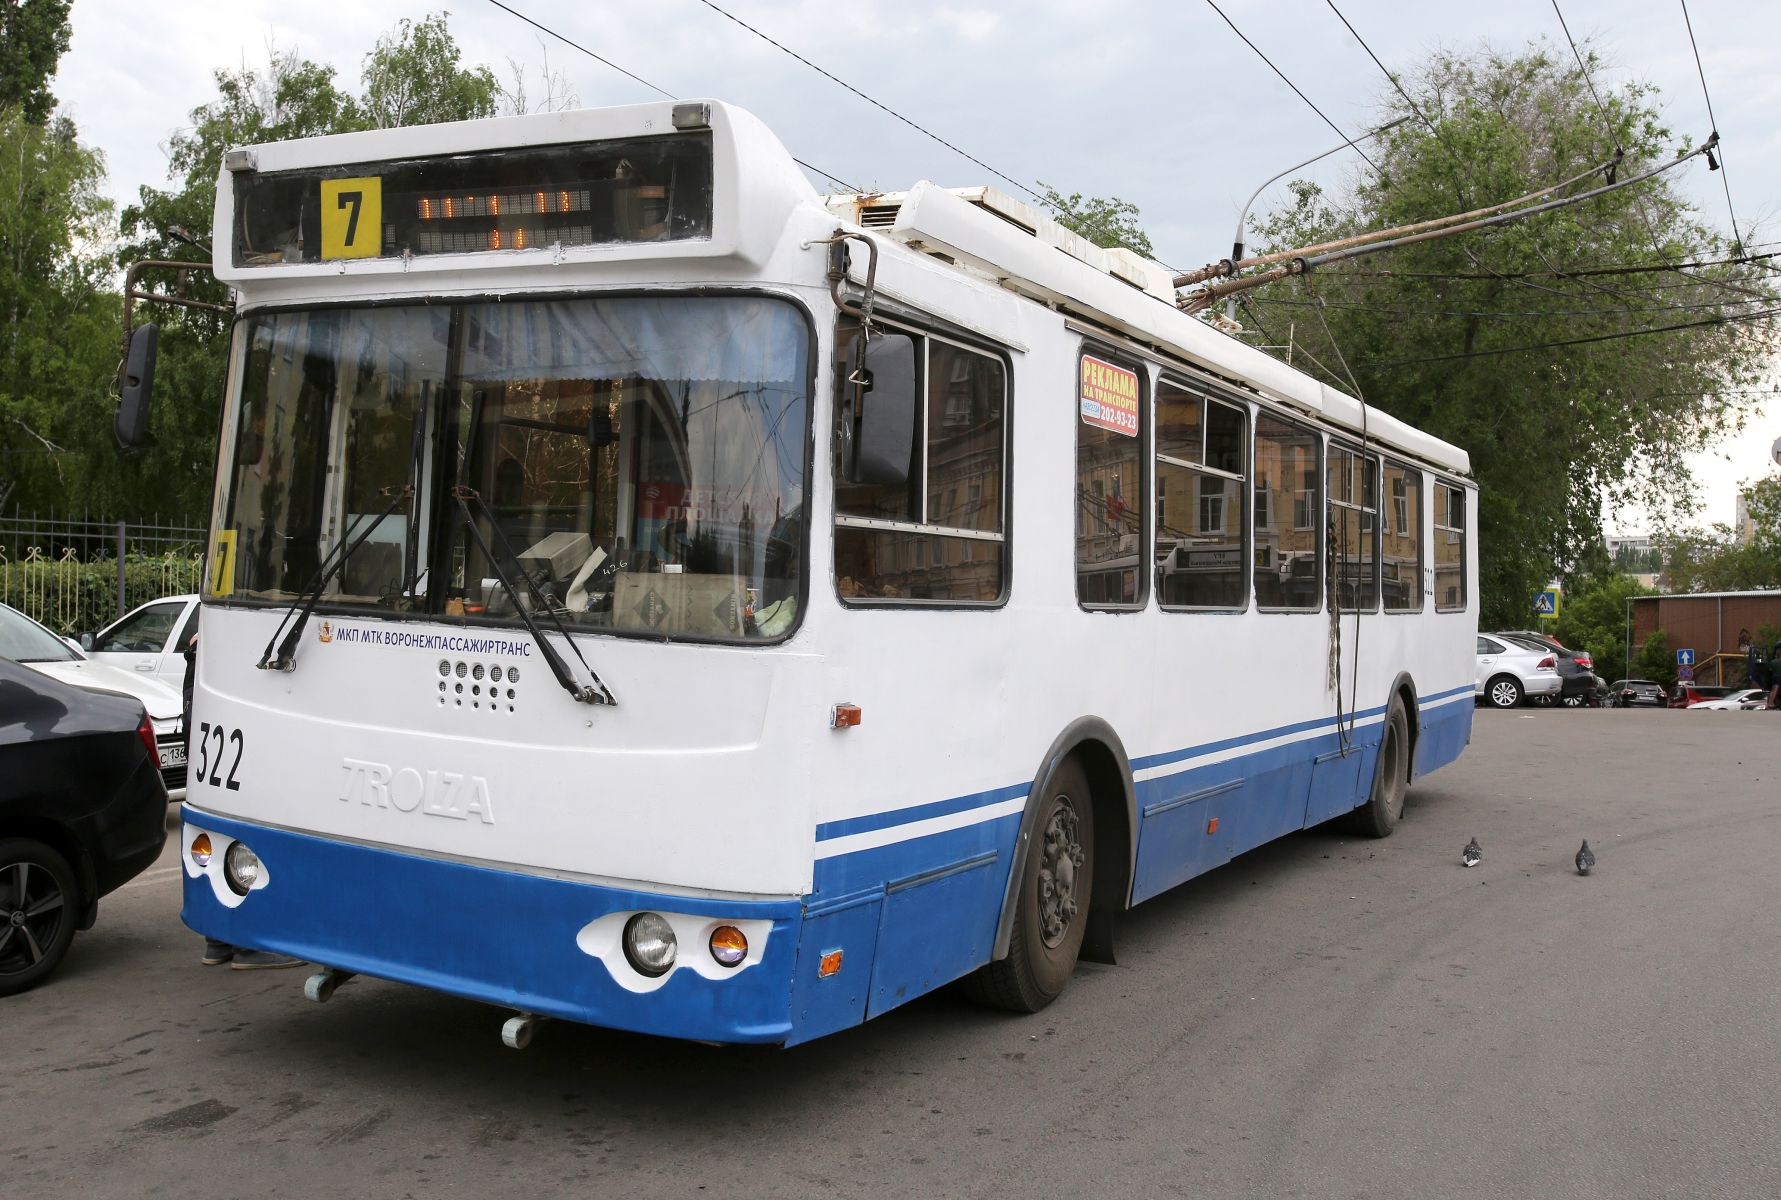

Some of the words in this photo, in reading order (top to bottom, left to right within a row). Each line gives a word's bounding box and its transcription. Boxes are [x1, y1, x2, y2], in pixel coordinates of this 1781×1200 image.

[337, 190, 363, 247] 7
[1083, 360, 1136, 399] РЕКЛАМА
[1083, 385, 1094, 398] НА
[1094, 387, 1137, 412] ТРАНСПОРТЕ
[665, 505, 773, 524] ПЛОЩАКА
[215, 541, 229, 592] 7
[602, 559, 628, 576] 426
[336, 628, 359, 642] МКП
[361, 629, 383, 644] МТК
[384, 631, 531, 657] ВОРОНЕЖПАССАЖИРТРАНС
[196, 721, 243, 791] 322
[338, 757, 495, 825] TROLZA
